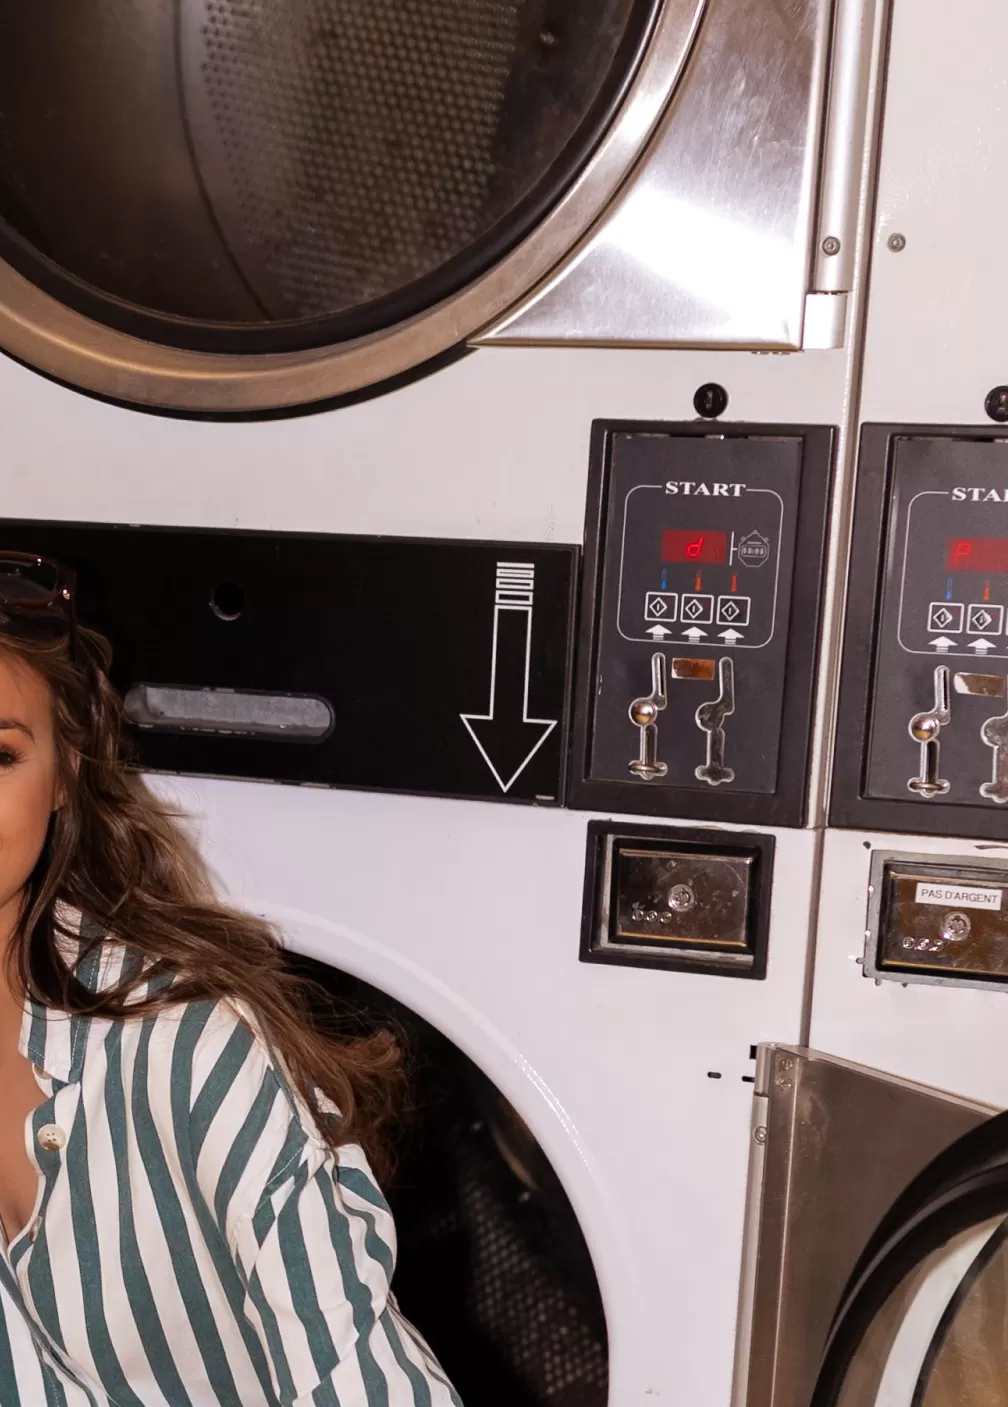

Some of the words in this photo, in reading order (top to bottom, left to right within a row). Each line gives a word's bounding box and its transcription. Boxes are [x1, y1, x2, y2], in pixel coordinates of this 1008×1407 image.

[665, 480, 747, 497] START
[951, 486, 1008, 503] STA
[921, 888, 943, 899] PAS
[944, 890, 999, 904] D'ARGENT
